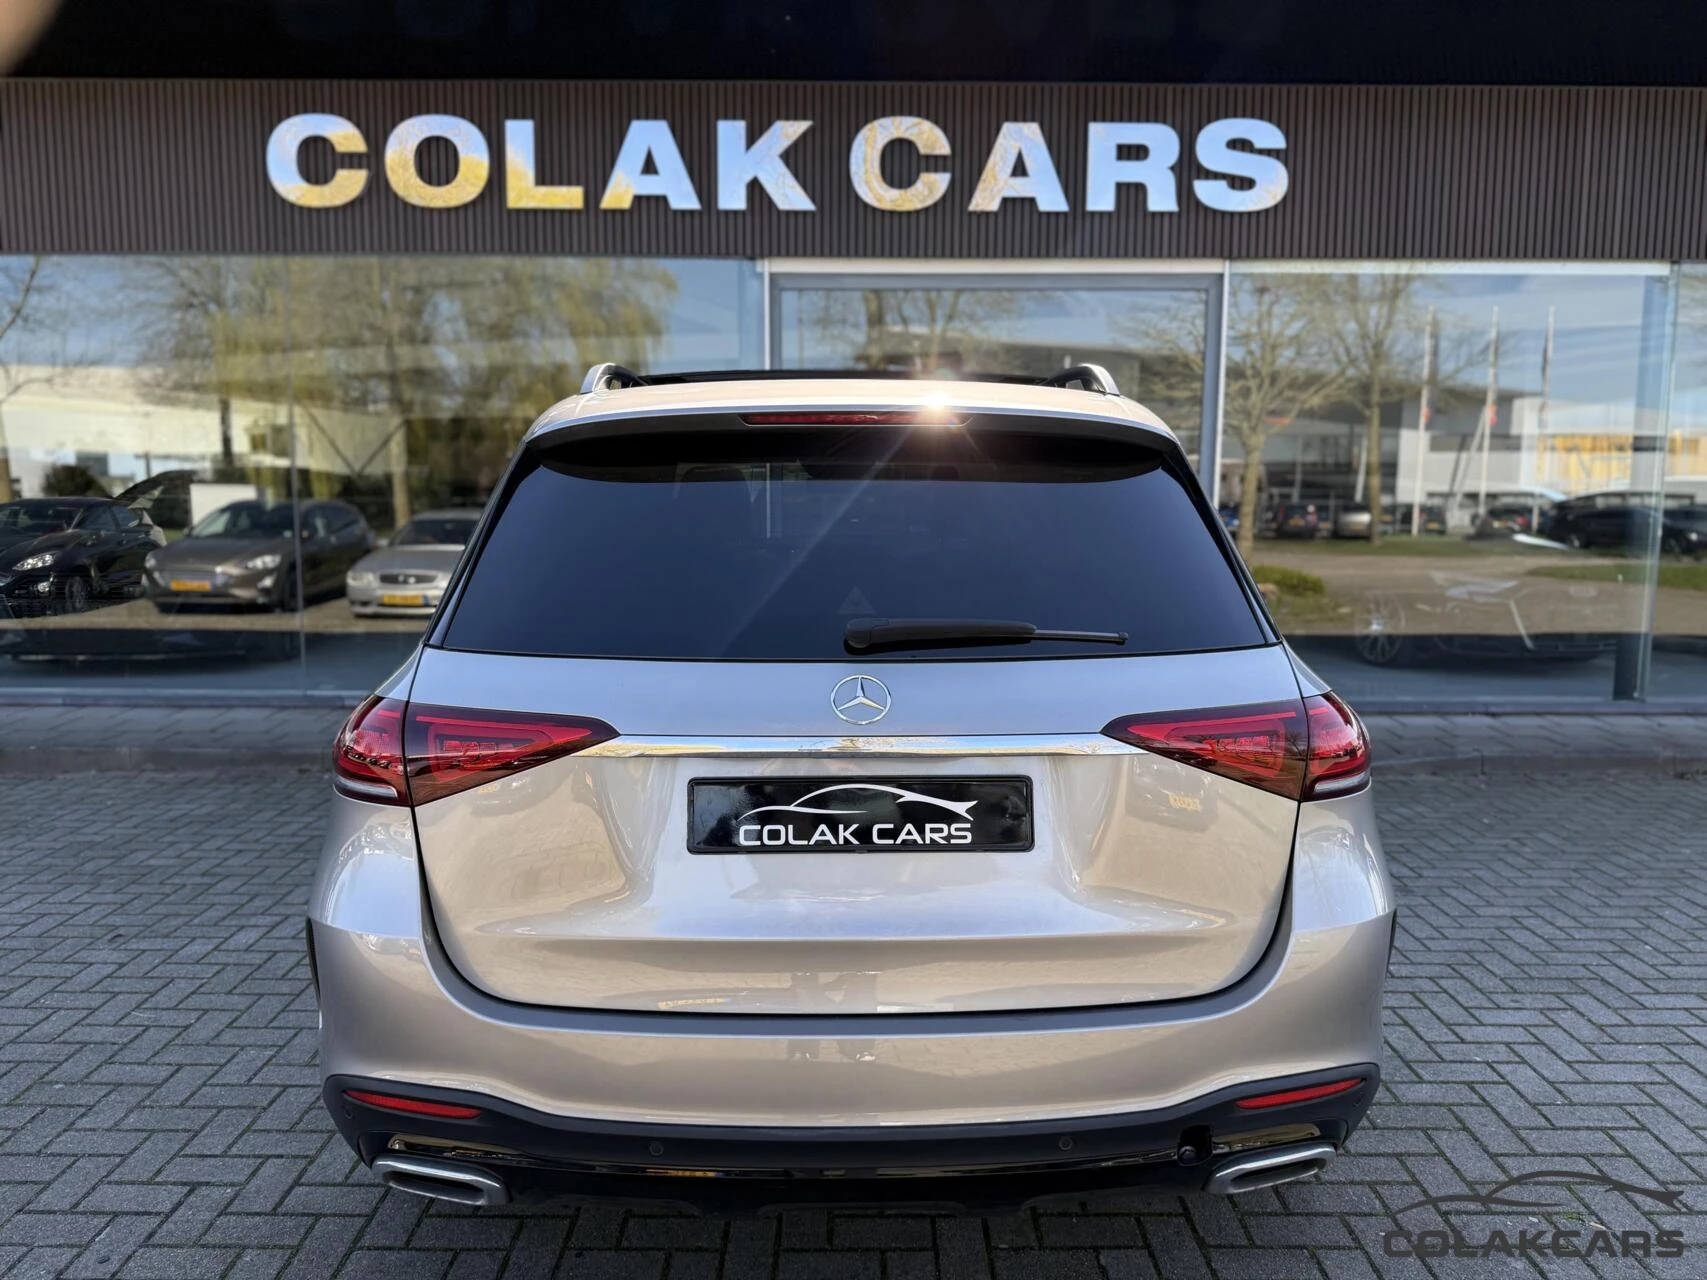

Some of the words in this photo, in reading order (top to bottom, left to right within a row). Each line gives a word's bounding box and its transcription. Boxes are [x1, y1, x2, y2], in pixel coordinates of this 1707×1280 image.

[266, 113, 816, 211] COLAK
[848, 116, 1289, 213] CARS
[739, 823, 860, 845] COLAK
[872, 823, 972, 844] CARS
